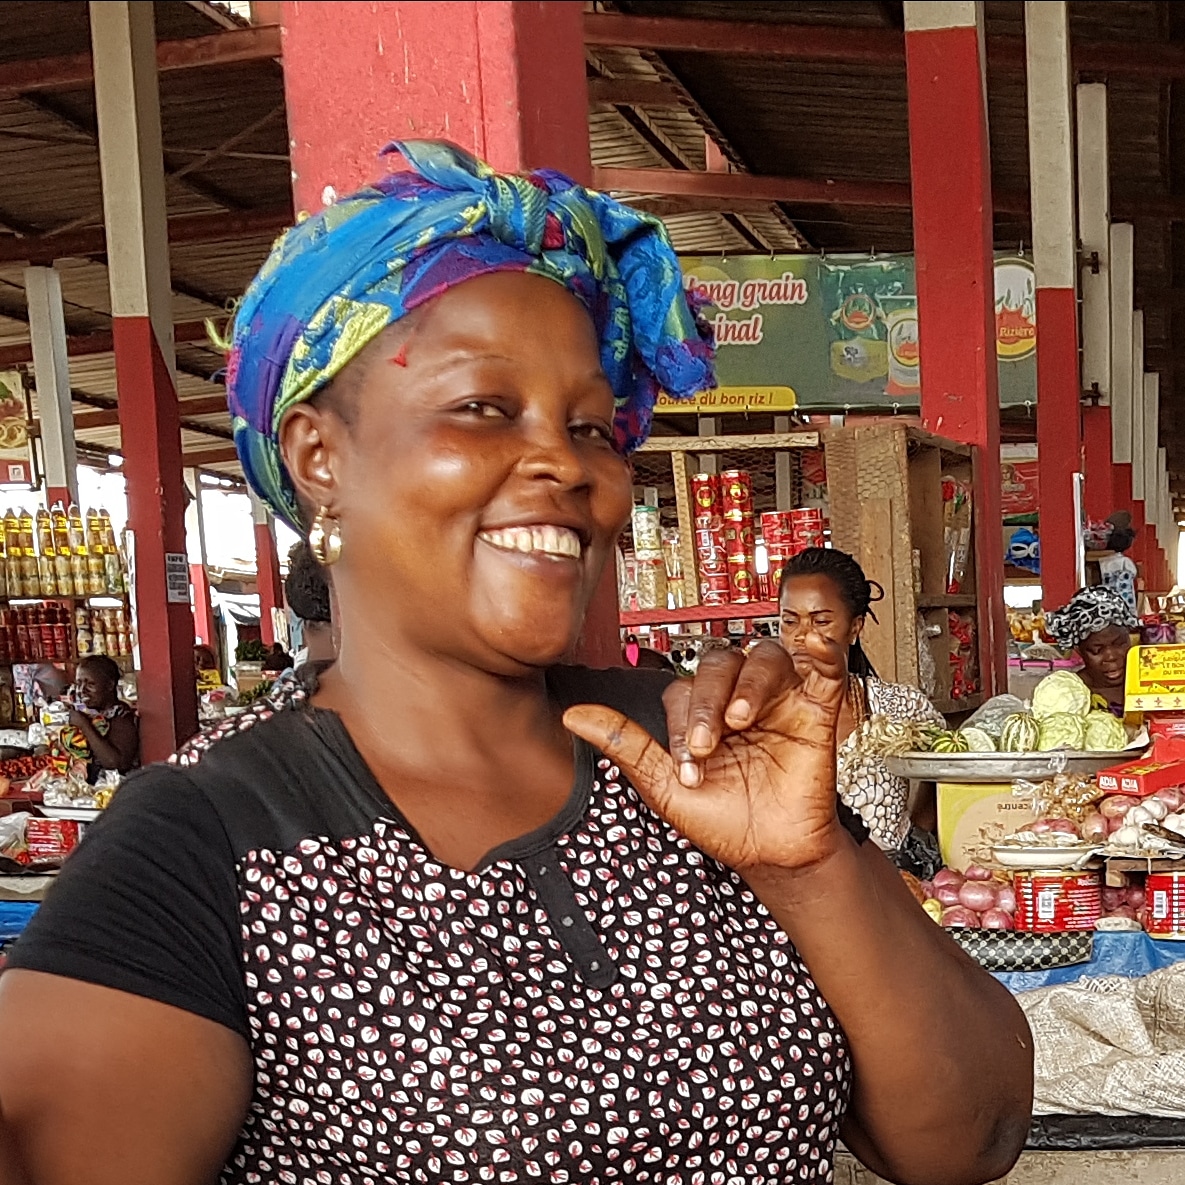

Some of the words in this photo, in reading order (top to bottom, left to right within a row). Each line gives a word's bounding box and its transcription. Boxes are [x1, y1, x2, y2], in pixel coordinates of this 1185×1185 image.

[743, 275, 805, 308] grain
[716, 316, 760, 342] inal
[658, 392, 696, 405] ource
[700, 393, 716, 405] du
[720, 393, 744, 405] bon
[749, 394, 765, 405] riz
